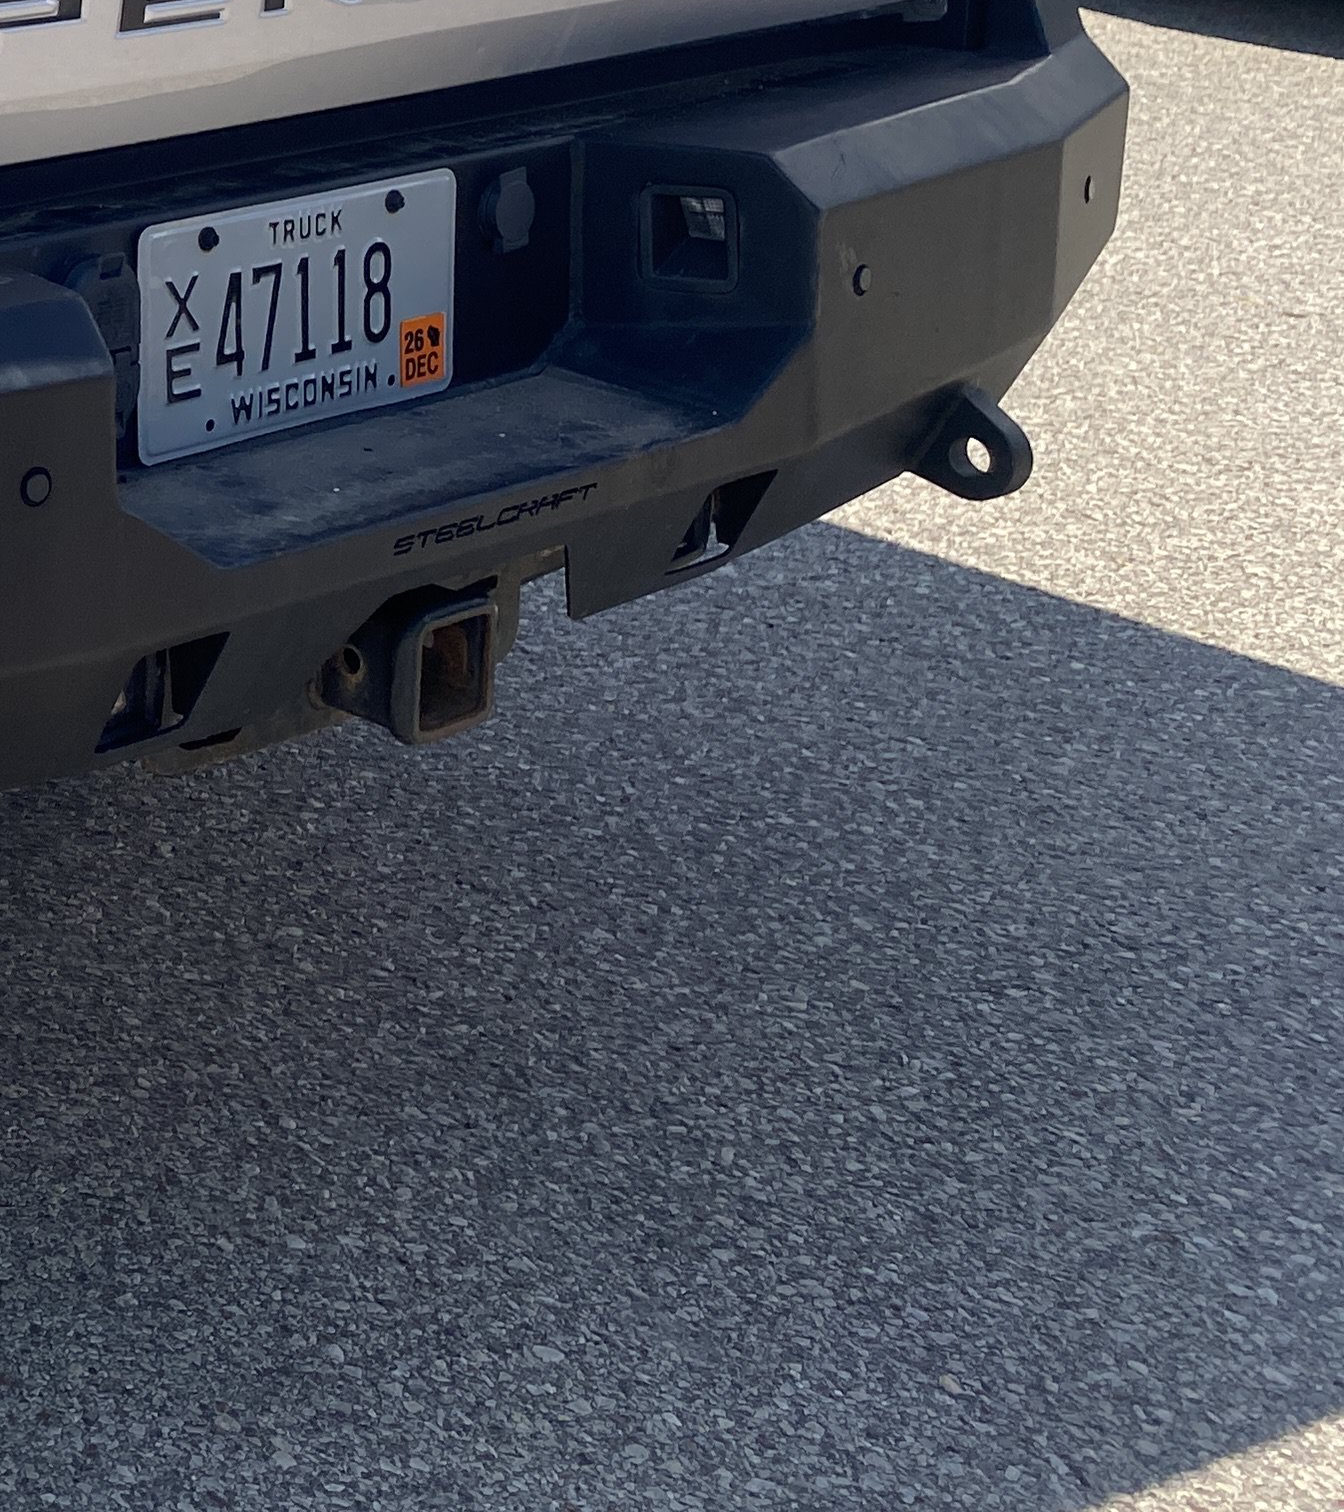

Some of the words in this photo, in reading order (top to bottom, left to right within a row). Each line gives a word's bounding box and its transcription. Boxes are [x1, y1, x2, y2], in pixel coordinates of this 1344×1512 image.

[268, 208, 343, 246] TRUCK
[215, 240, 393, 377] 47118
[404, 327, 425, 355] 26
[404, 351, 440, 381] DEC
[230, 363, 379, 425] WISCONSIN
[393, 482, 598, 556] STEELCRAFT
